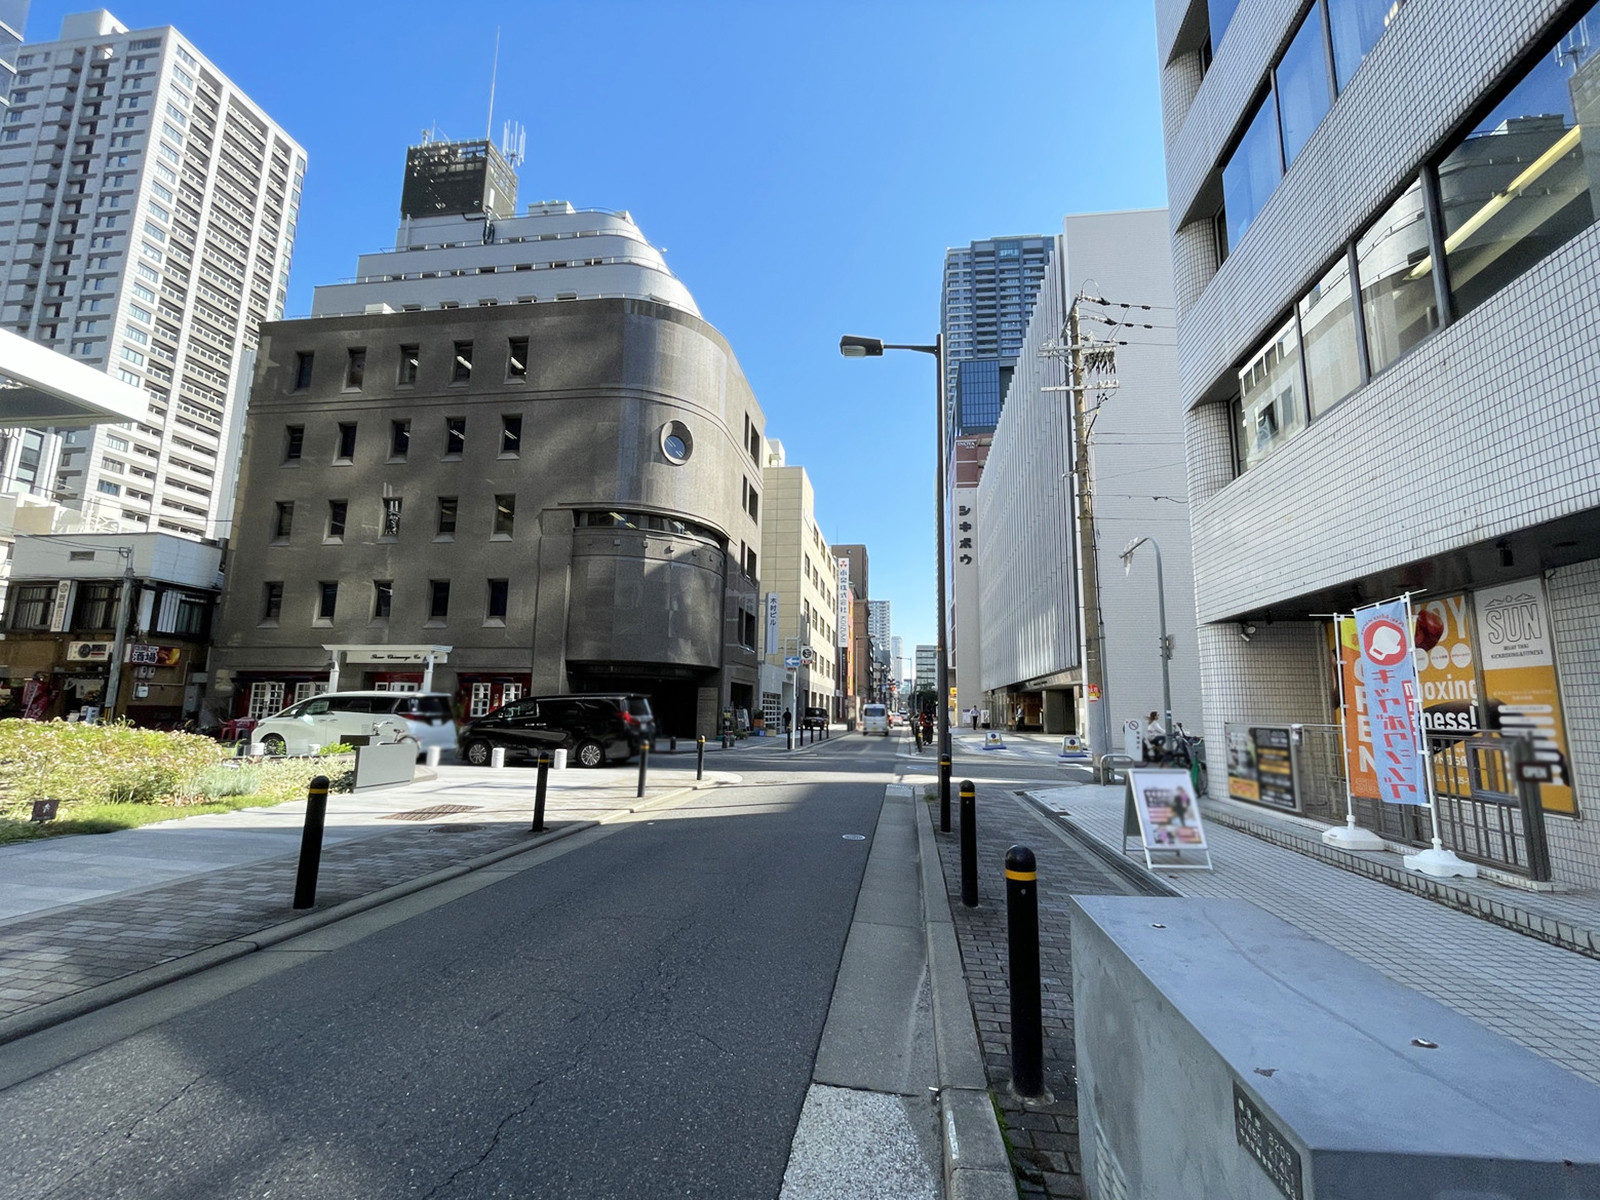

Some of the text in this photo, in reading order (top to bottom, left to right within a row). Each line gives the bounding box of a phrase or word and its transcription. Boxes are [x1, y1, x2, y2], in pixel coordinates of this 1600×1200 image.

[958, 505, 972, 565] シキボウ
[1486, 603, 1542, 645] SUN
[1371, 669, 1417, 799] キックボクシング
